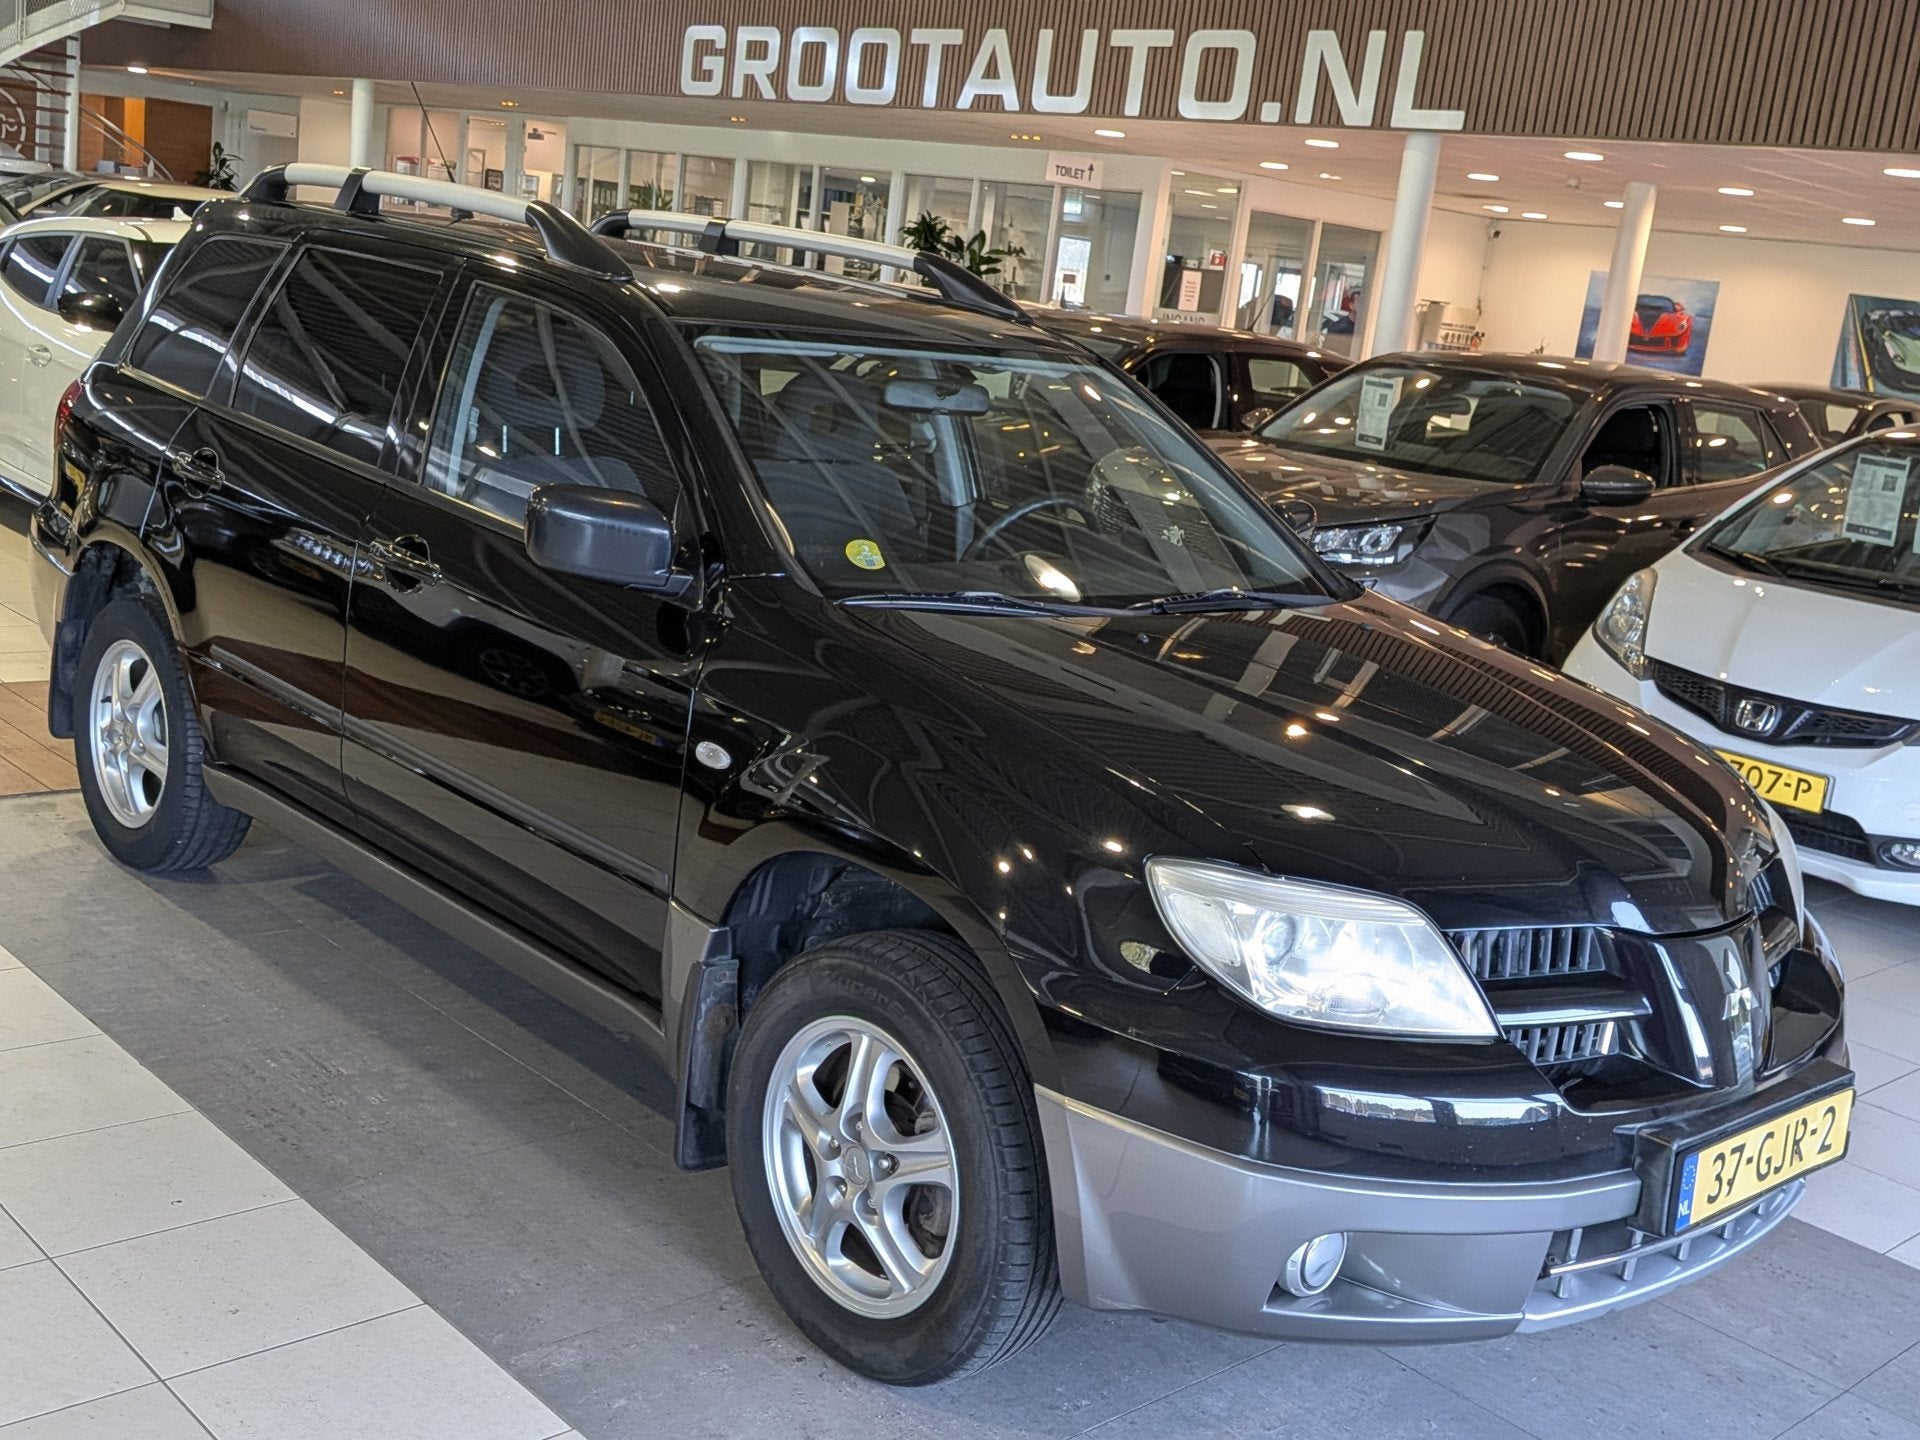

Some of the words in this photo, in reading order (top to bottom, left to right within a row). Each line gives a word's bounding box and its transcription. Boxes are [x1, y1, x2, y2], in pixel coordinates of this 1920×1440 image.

[680, 25, 1465, 131] GROOTAUTO.NL
[1055, 164, 1085, 180] TOILET
[1706, 1105, 1836, 1205] 37-GJR-2
[1677, 1199, 1690, 1219] NL
